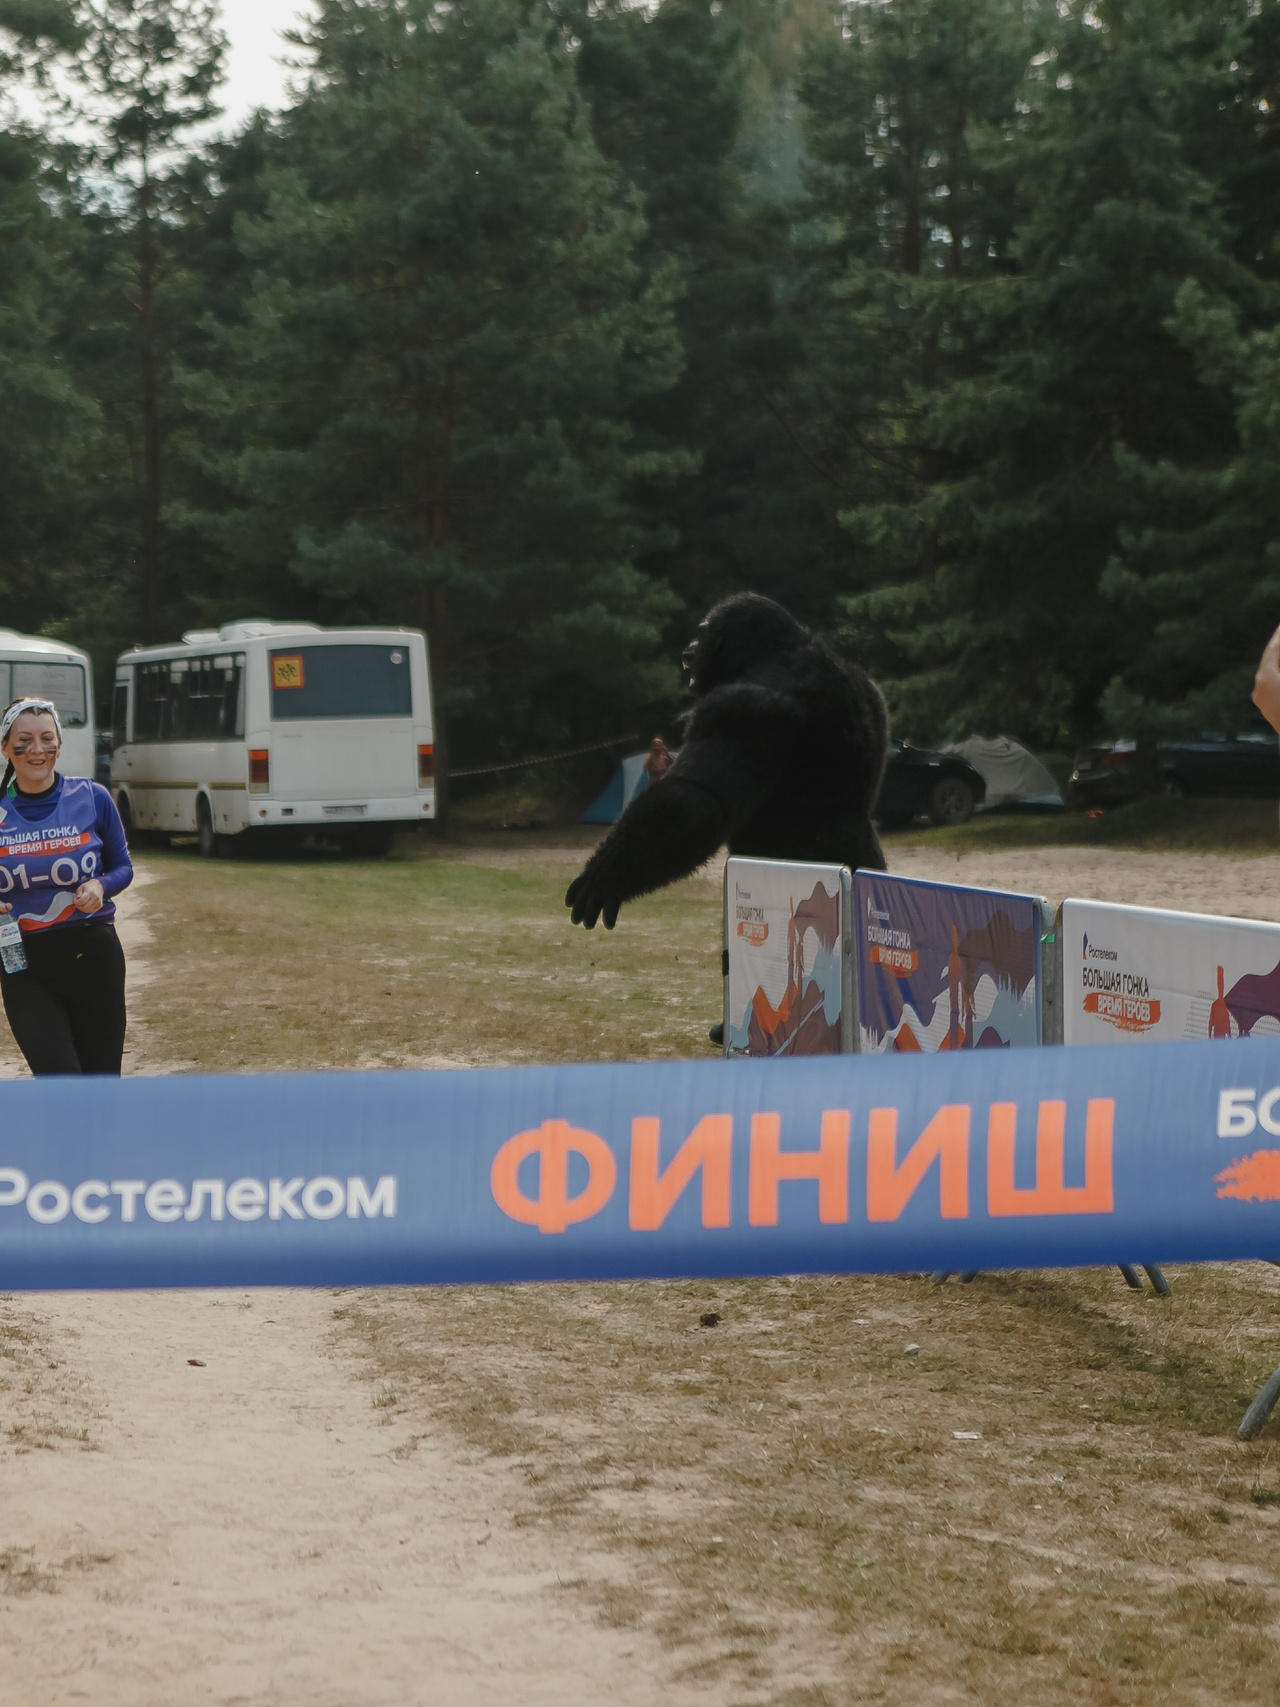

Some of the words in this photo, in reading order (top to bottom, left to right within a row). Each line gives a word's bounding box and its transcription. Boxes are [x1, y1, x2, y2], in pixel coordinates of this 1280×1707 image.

[42, 826, 80, 841] ГОНКА
[8, 842, 43, 856] ВРЕМЯ
[44, 835, 81, 850] ГЕРОЕВ
[892, 931, 911, 950] ГОНКА
[1088, 944, 1118, 961] Ростелеком
[1082, 967, 1121, 992] БОЛЬШАЯ
[1123, 974, 1150, 998] ГОНКА
[1097, 994, 1122, 1016] ВРЕМЯ
[1123, 999, 1151, 1022] ГЕРОЕВ
[489, 1098, 1116, 1235] ФИНИШ
